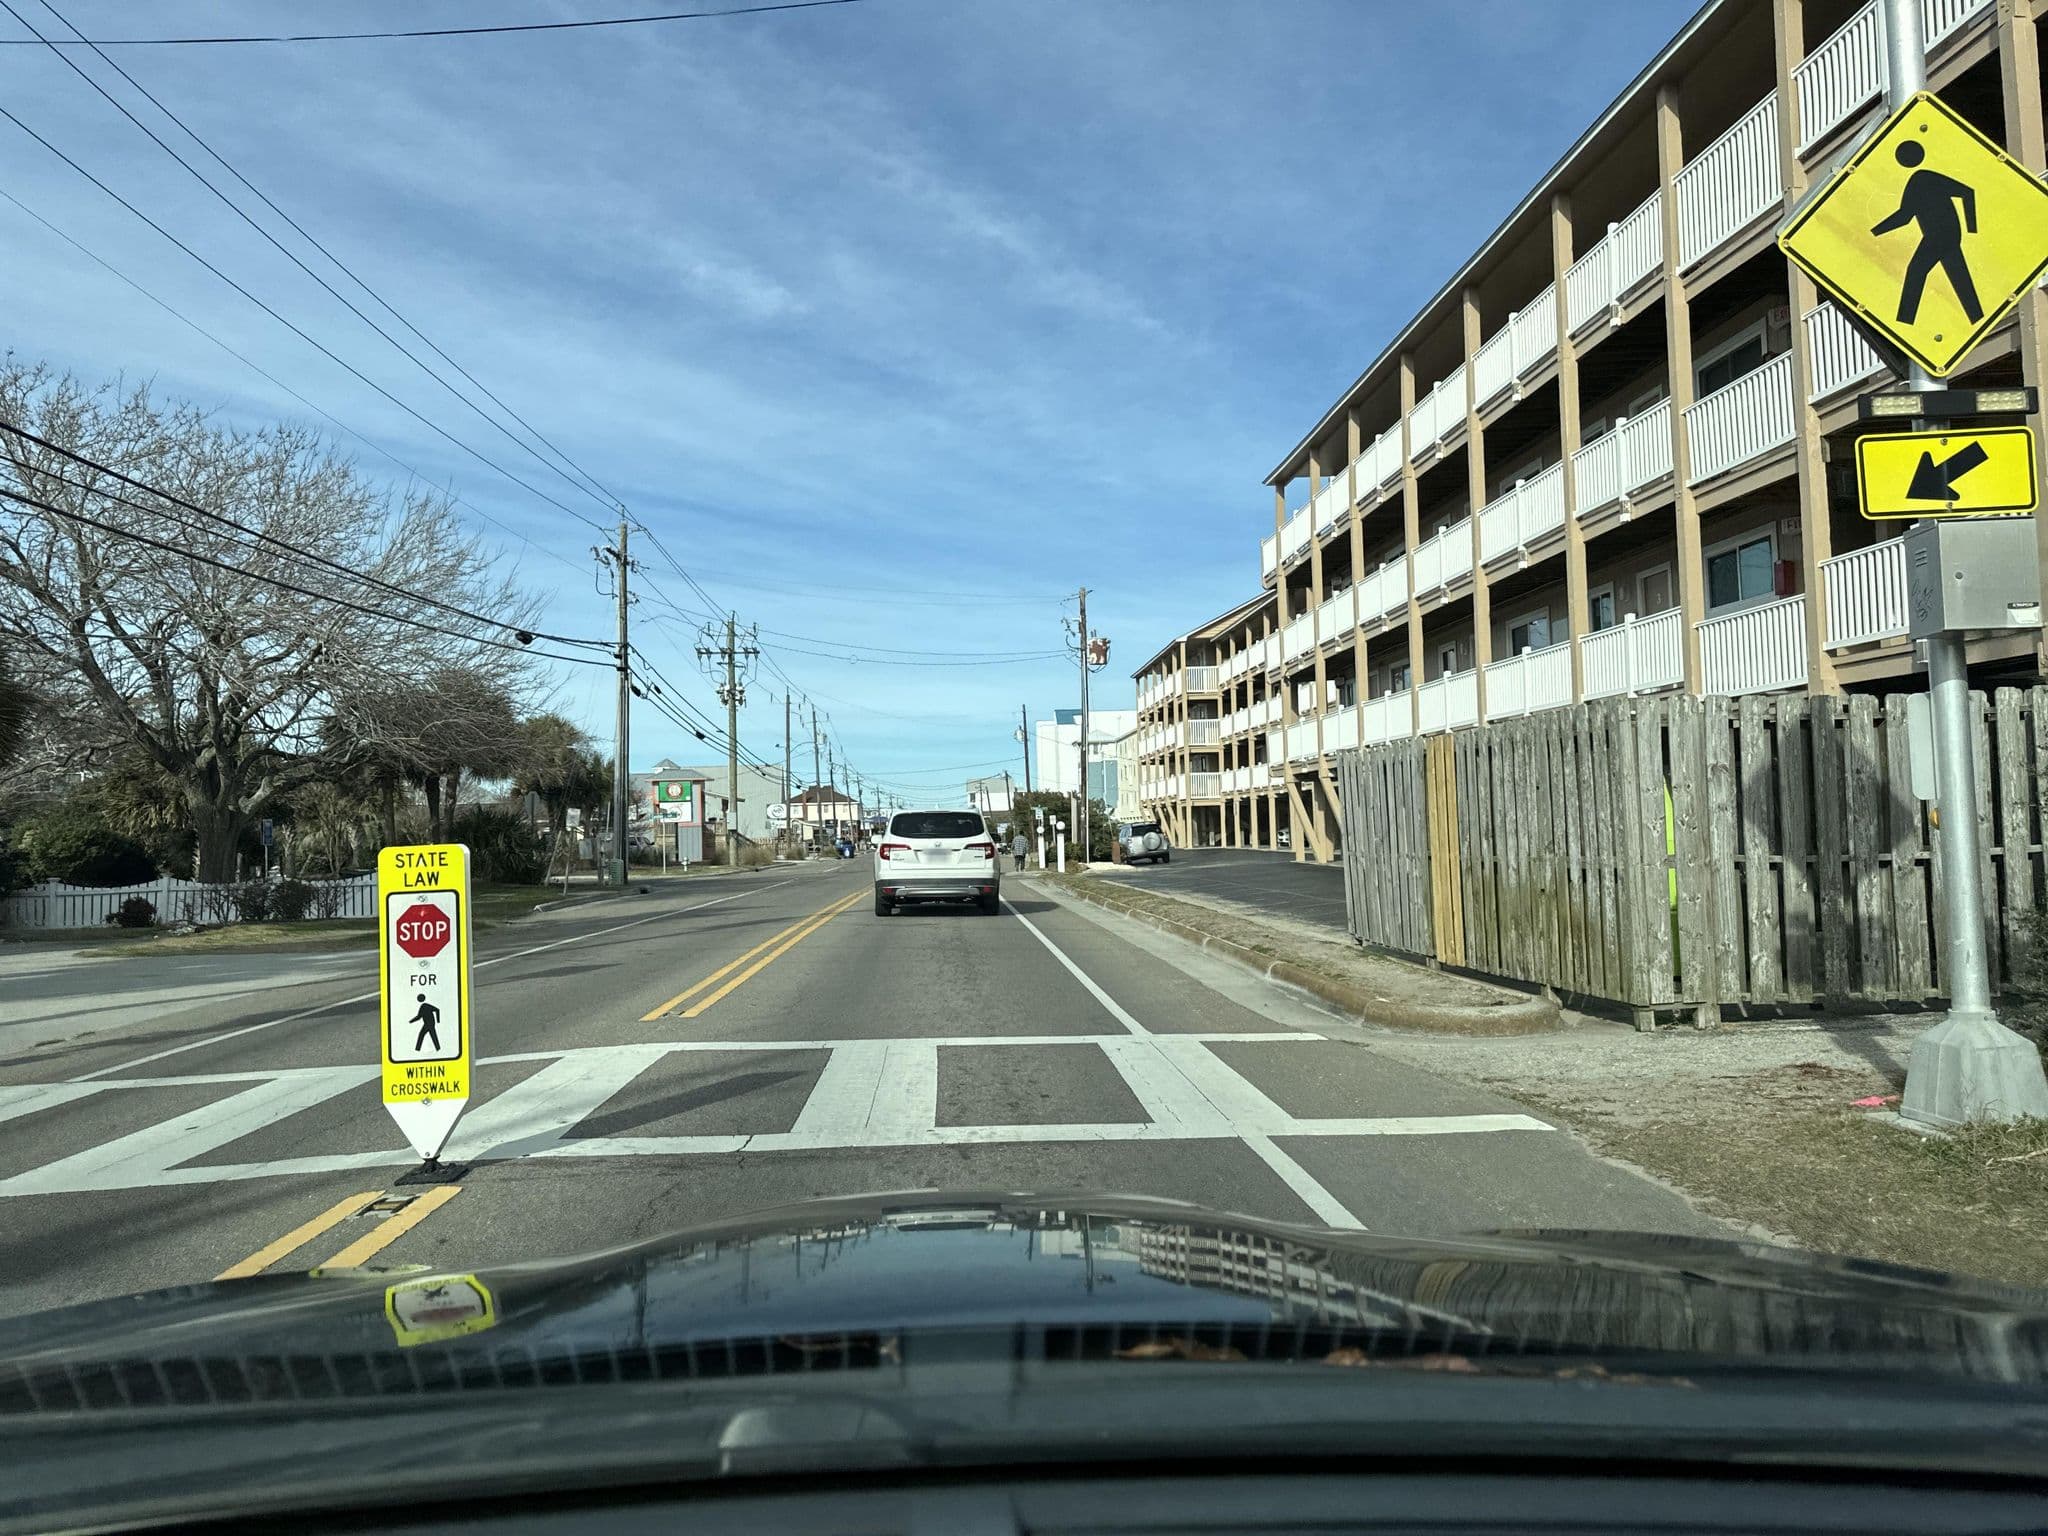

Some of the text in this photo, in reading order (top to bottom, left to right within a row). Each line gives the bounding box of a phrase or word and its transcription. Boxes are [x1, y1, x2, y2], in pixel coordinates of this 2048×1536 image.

[395, 851, 449, 869] STATE
[404, 871, 440, 888] LAW
[400, 920, 448, 941] STOP
[410, 973, 437, 987] FOR
[405, 1065, 446, 1079] WITHIN
[391, 1080, 460, 1097] CROSSWALK
